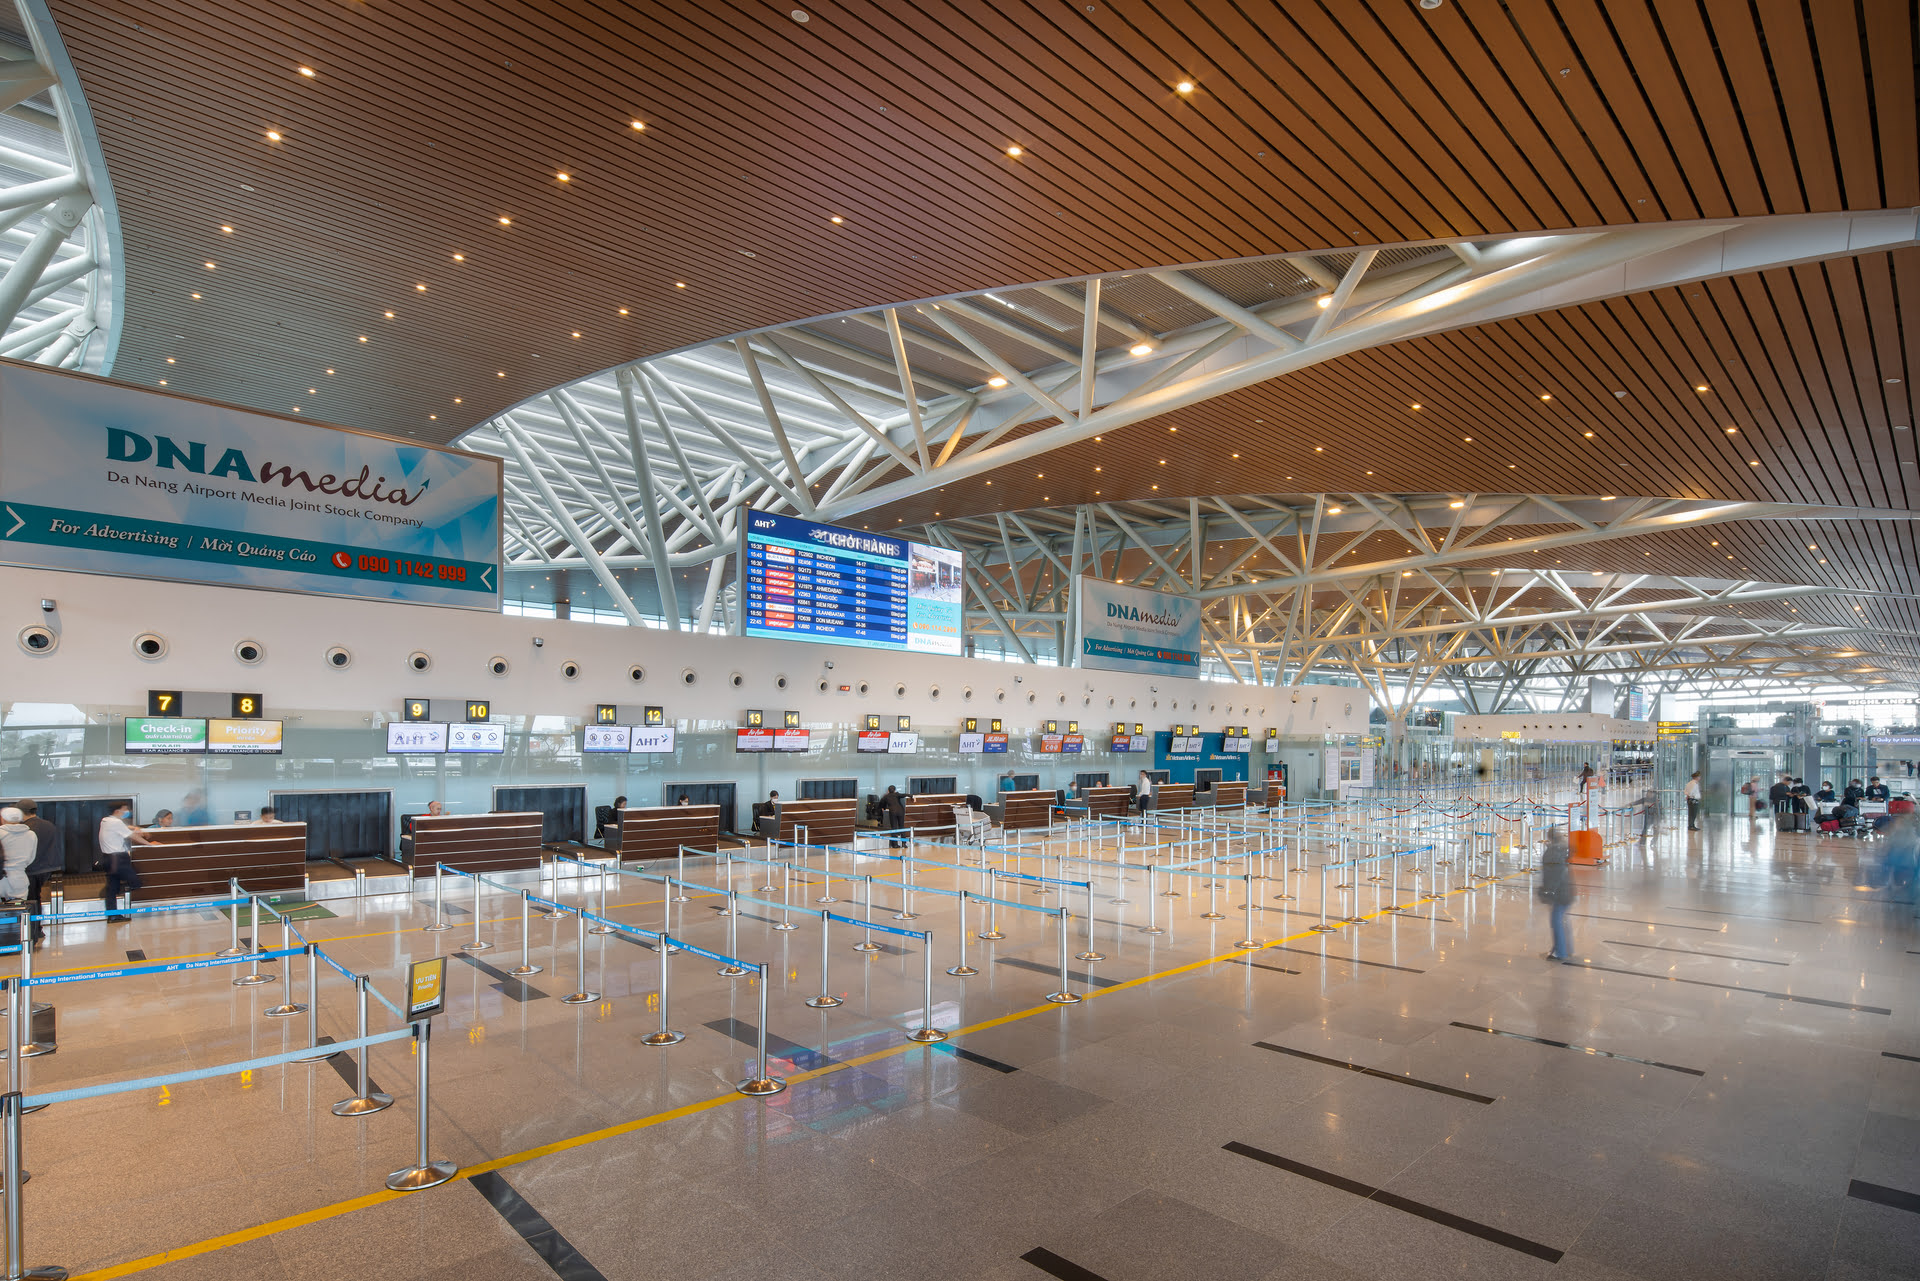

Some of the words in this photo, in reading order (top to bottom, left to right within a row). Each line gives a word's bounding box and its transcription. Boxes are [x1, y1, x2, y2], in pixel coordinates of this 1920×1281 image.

[106, 427, 426, 506] DNAmedia
[107, 471, 130, 484] Da
[135, 475, 178, 494] Nang
[183, 482, 237, 499] Airport
[241, 491, 286, 507] Media
[290, 498, 321, 512] Joint
[325, 504, 361, 518] Stock
[364, 510, 424, 529] Company
[49, 518, 81, 534] For
[83, 523, 179, 549] Advertising
[200, 537, 233, 553] Mời
[237, 541, 286, 561] Quảng
[289, 548, 316, 563] Cáo
[358, 554, 390, 573] 090
[394, 559, 434, 579] 1142
[438, 564, 467, 582] 999
[1107, 602, 1180, 627] DNAmedia
[158, 695, 172, 711] 7
[240, 698, 253, 713] 8
[412, 703, 423, 717] 9
[469, 705, 487, 718] 10
[600, 708, 614, 720] 11
[647, 710, 661, 721] 12
[749, 713, 761, 724] 13
[786, 714, 798, 725] 14
[868, 718, 879, 728] 15
[899, 718, 909, 728] 16
[140, 724, 192, 733] Check-in
[967, 720, 976, 730] 17
[992, 721, 1000, 730] 18
[1048, 723, 1056, 731] 19
[1069, 723, 1077, 732] 20
[1117, 725, 1124, 733] 21
[1135, 725, 1142, 734] 22
[225, 726, 266, 736] Priority
[635, 738, 660, 746] AHT
[210, 957, 242, 965] International
[243, 953, 265, 961] Terminal
[57, 973, 96, 982] International
[97, 970, 122, 978] Terminal
